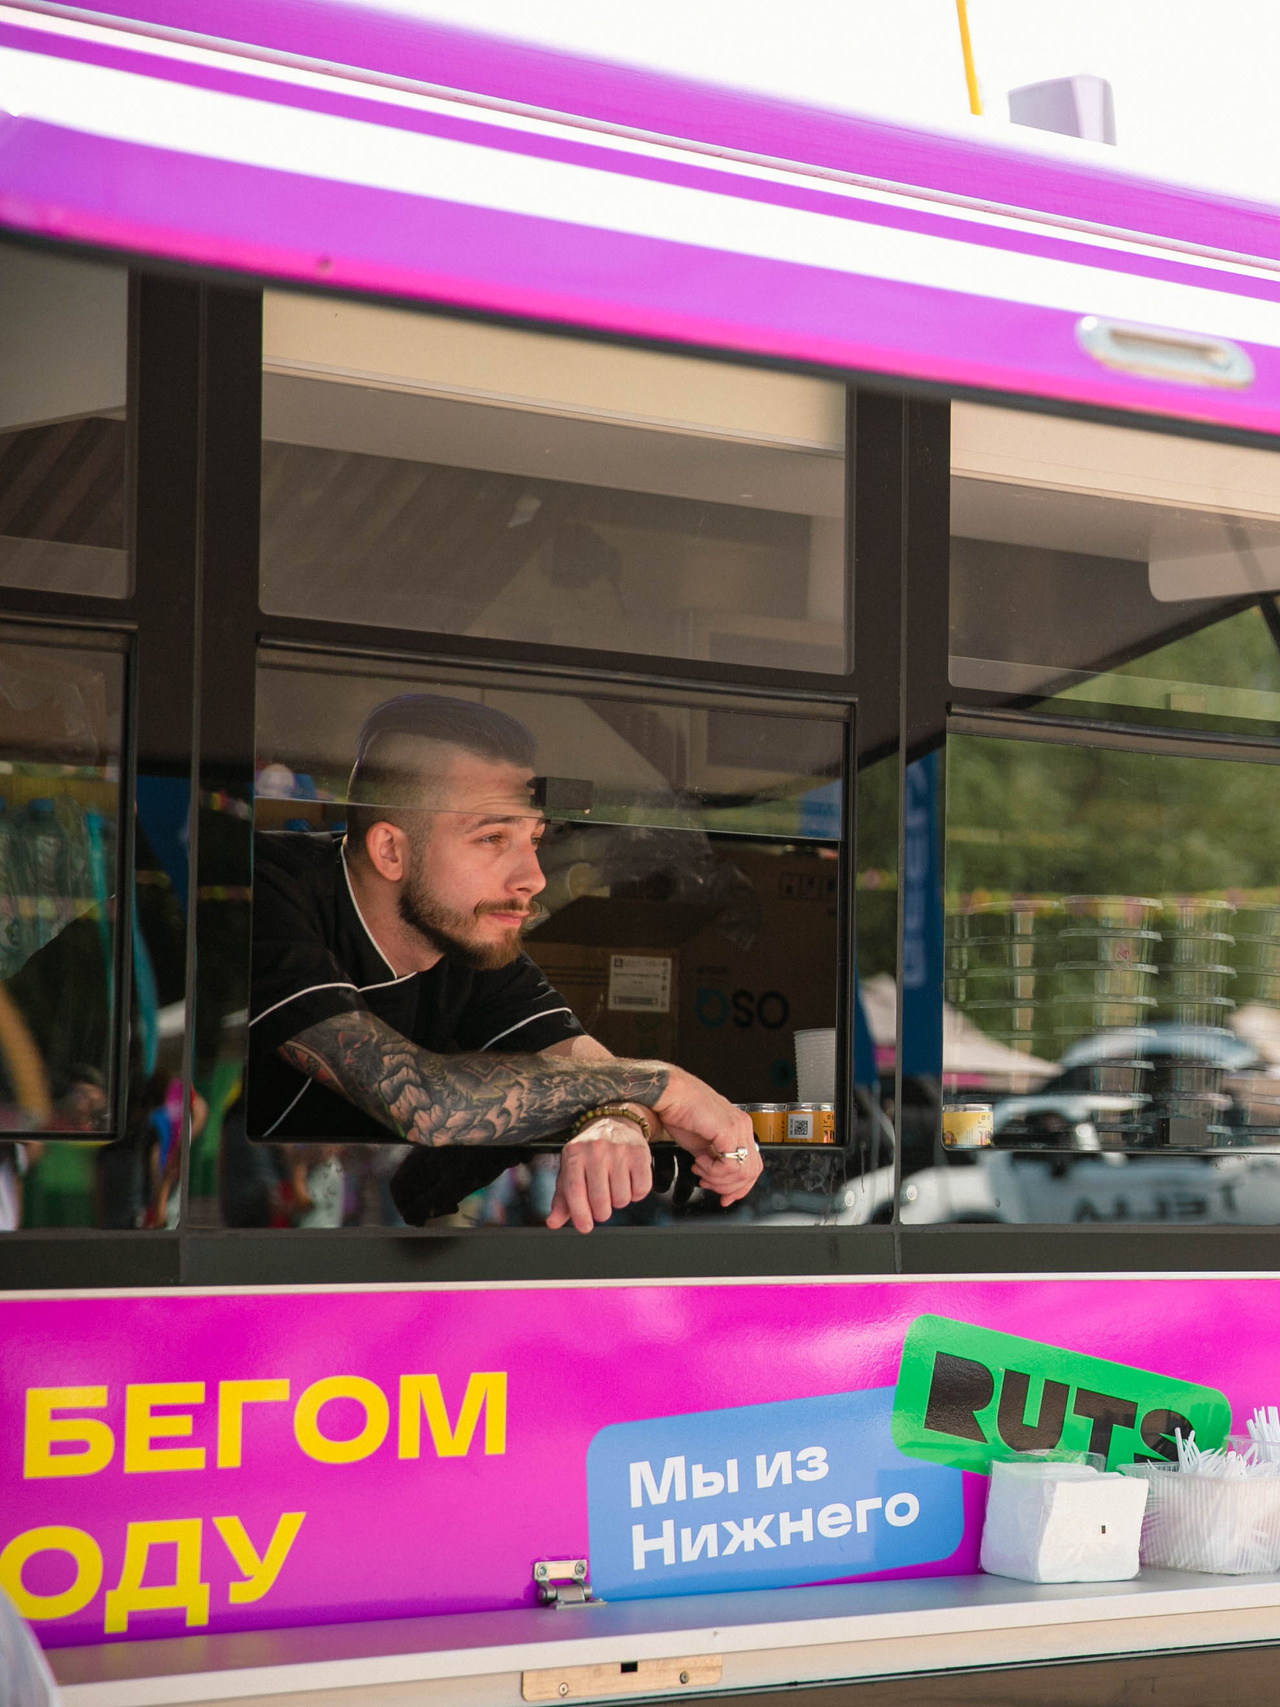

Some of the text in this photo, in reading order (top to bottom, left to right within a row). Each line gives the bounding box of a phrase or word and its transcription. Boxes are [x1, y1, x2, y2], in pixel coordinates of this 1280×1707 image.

[24, 1371, 507, 1479] БЕГОМ
[924, 1351, 1196, 1472] RUTS
[629, 1446, 829, 1508] Мы из
[0, 1512, 306, 1634] ОДУ
[631, 1492, 920, 1571] Нижнего
